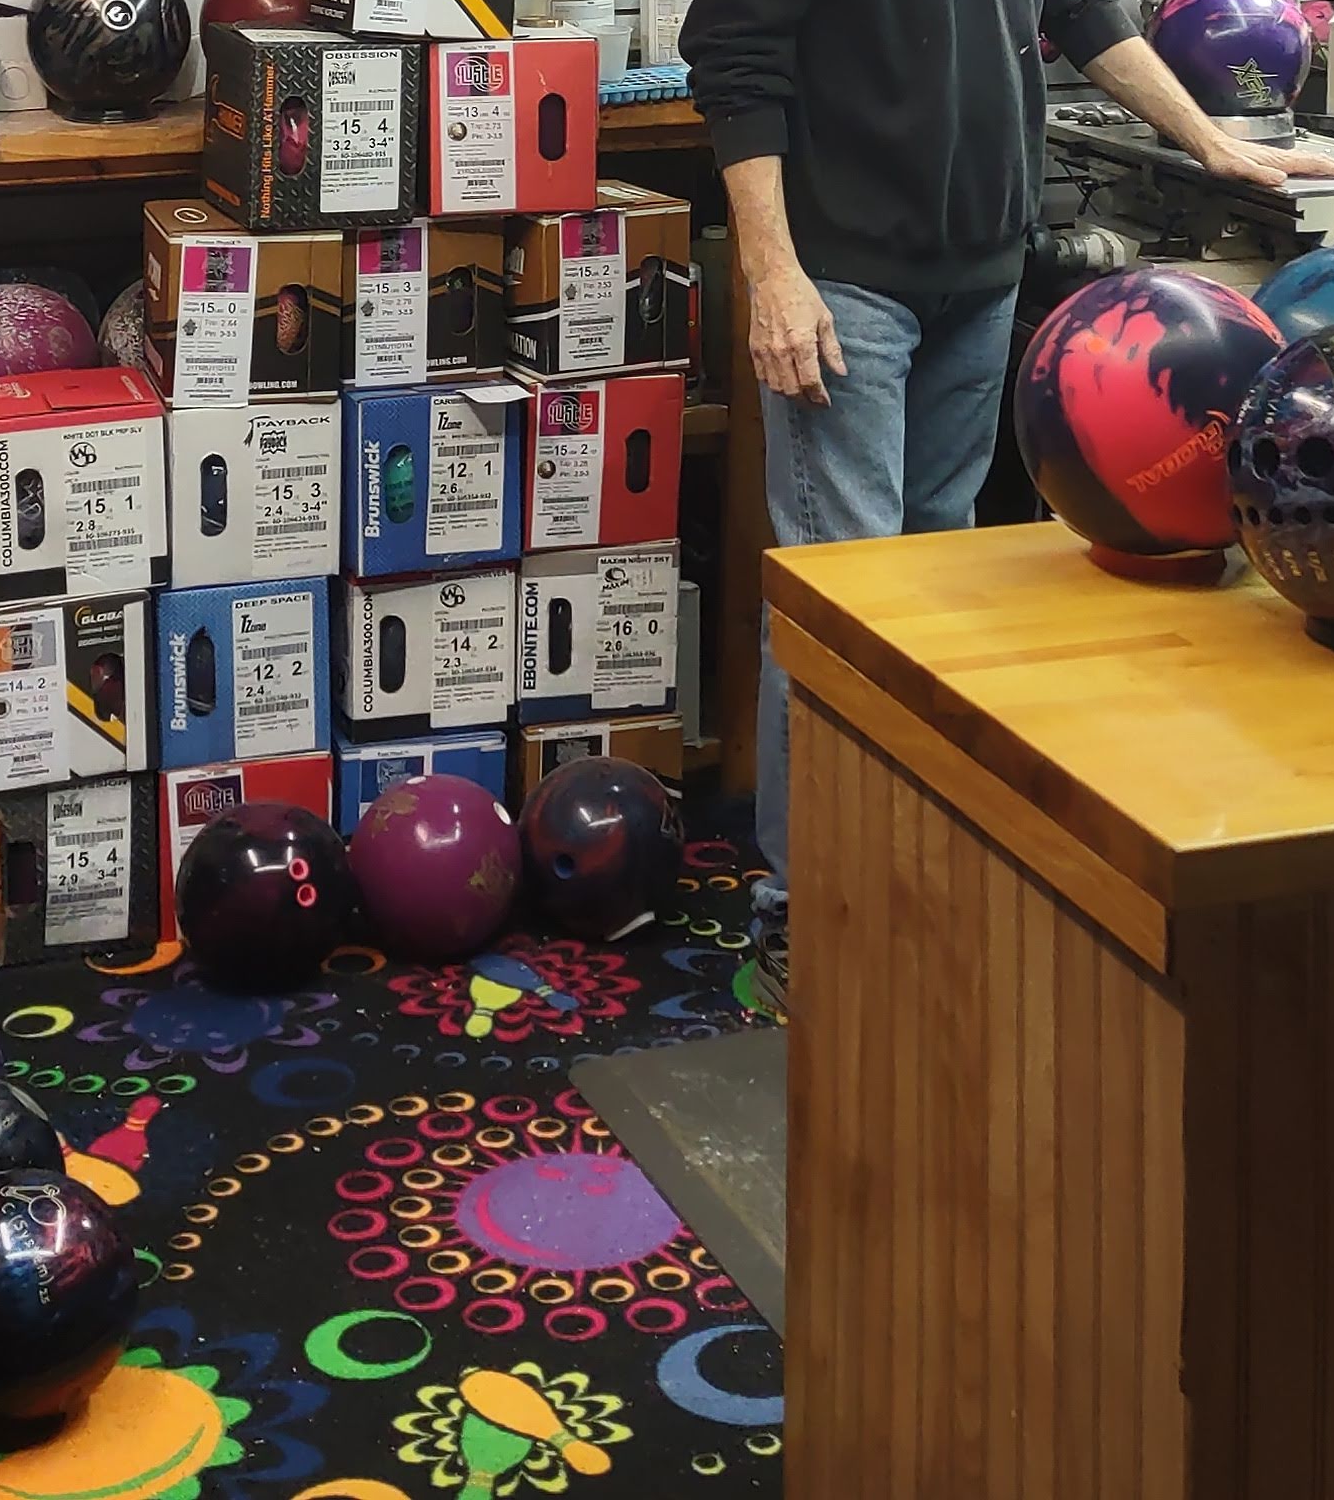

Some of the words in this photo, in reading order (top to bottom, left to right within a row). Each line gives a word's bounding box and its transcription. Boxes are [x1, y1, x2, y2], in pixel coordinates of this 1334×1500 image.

[325, 51, 399, 60] OBSESSION
[464, 106, 479, 118] 13
[492, 105, 500, 116] 4
[340, 118, 361, 135] 15
[377, 117, 389, 134] 4
[332, 140, 351, 151] 3.2
[368, 136, 394, 149] 3-4"
[579, 266, 592, 278] 15
[603, 265, 610, 276] 2
[375, 283, 389, 294] 15
[403, 282, 411, 292] 3
[200, 303, 215, 313] 15
[228, 303, 236, 313] 0
[257, 416, 331, 429] PAYBACK
[554, 445, 568, 456] 15
[581, 444, 588, 455] 2
[447, 462, 467, 478] 12
[483, 460, 492, 476] 1
[271, 484, 293, 501] 15
[310, 482, 322, 498] 3
[364, 440, 381, 538] Brunswick
[439, 483, 458, 494] 2.6
[84, 498, 106, 515] 15
[124, 495, 134, 510] 1
[264, 505, 283, 517] 2.4
[76, 520, 96, 532] 2.8
[235, 599, 267, 609] DEEP
[270, 594, 311, 605] SPACE
[612, 620, 633, 636] 16
[648, 619, 658, 635] 0
[523, 582, 539, 690] EBONITE.COM
[451, 636, 472, 653] 14
[488, 634, 498, 650] 2
[443, 657, 462, 669] 2.3
[253, 664, 274, 681] 12
[292, 660, 303, 676] 2
[9, 680, 24, 692] 14
[37, 678, 46, 689] 2
[170, 633, 188, 732] Brunswick
[245, 685, 265, 698] 2.4
[67, 851, 89, 869] 15
[106, 847, 118, 864] 4
[58, 874, 78, 886] 2.9
